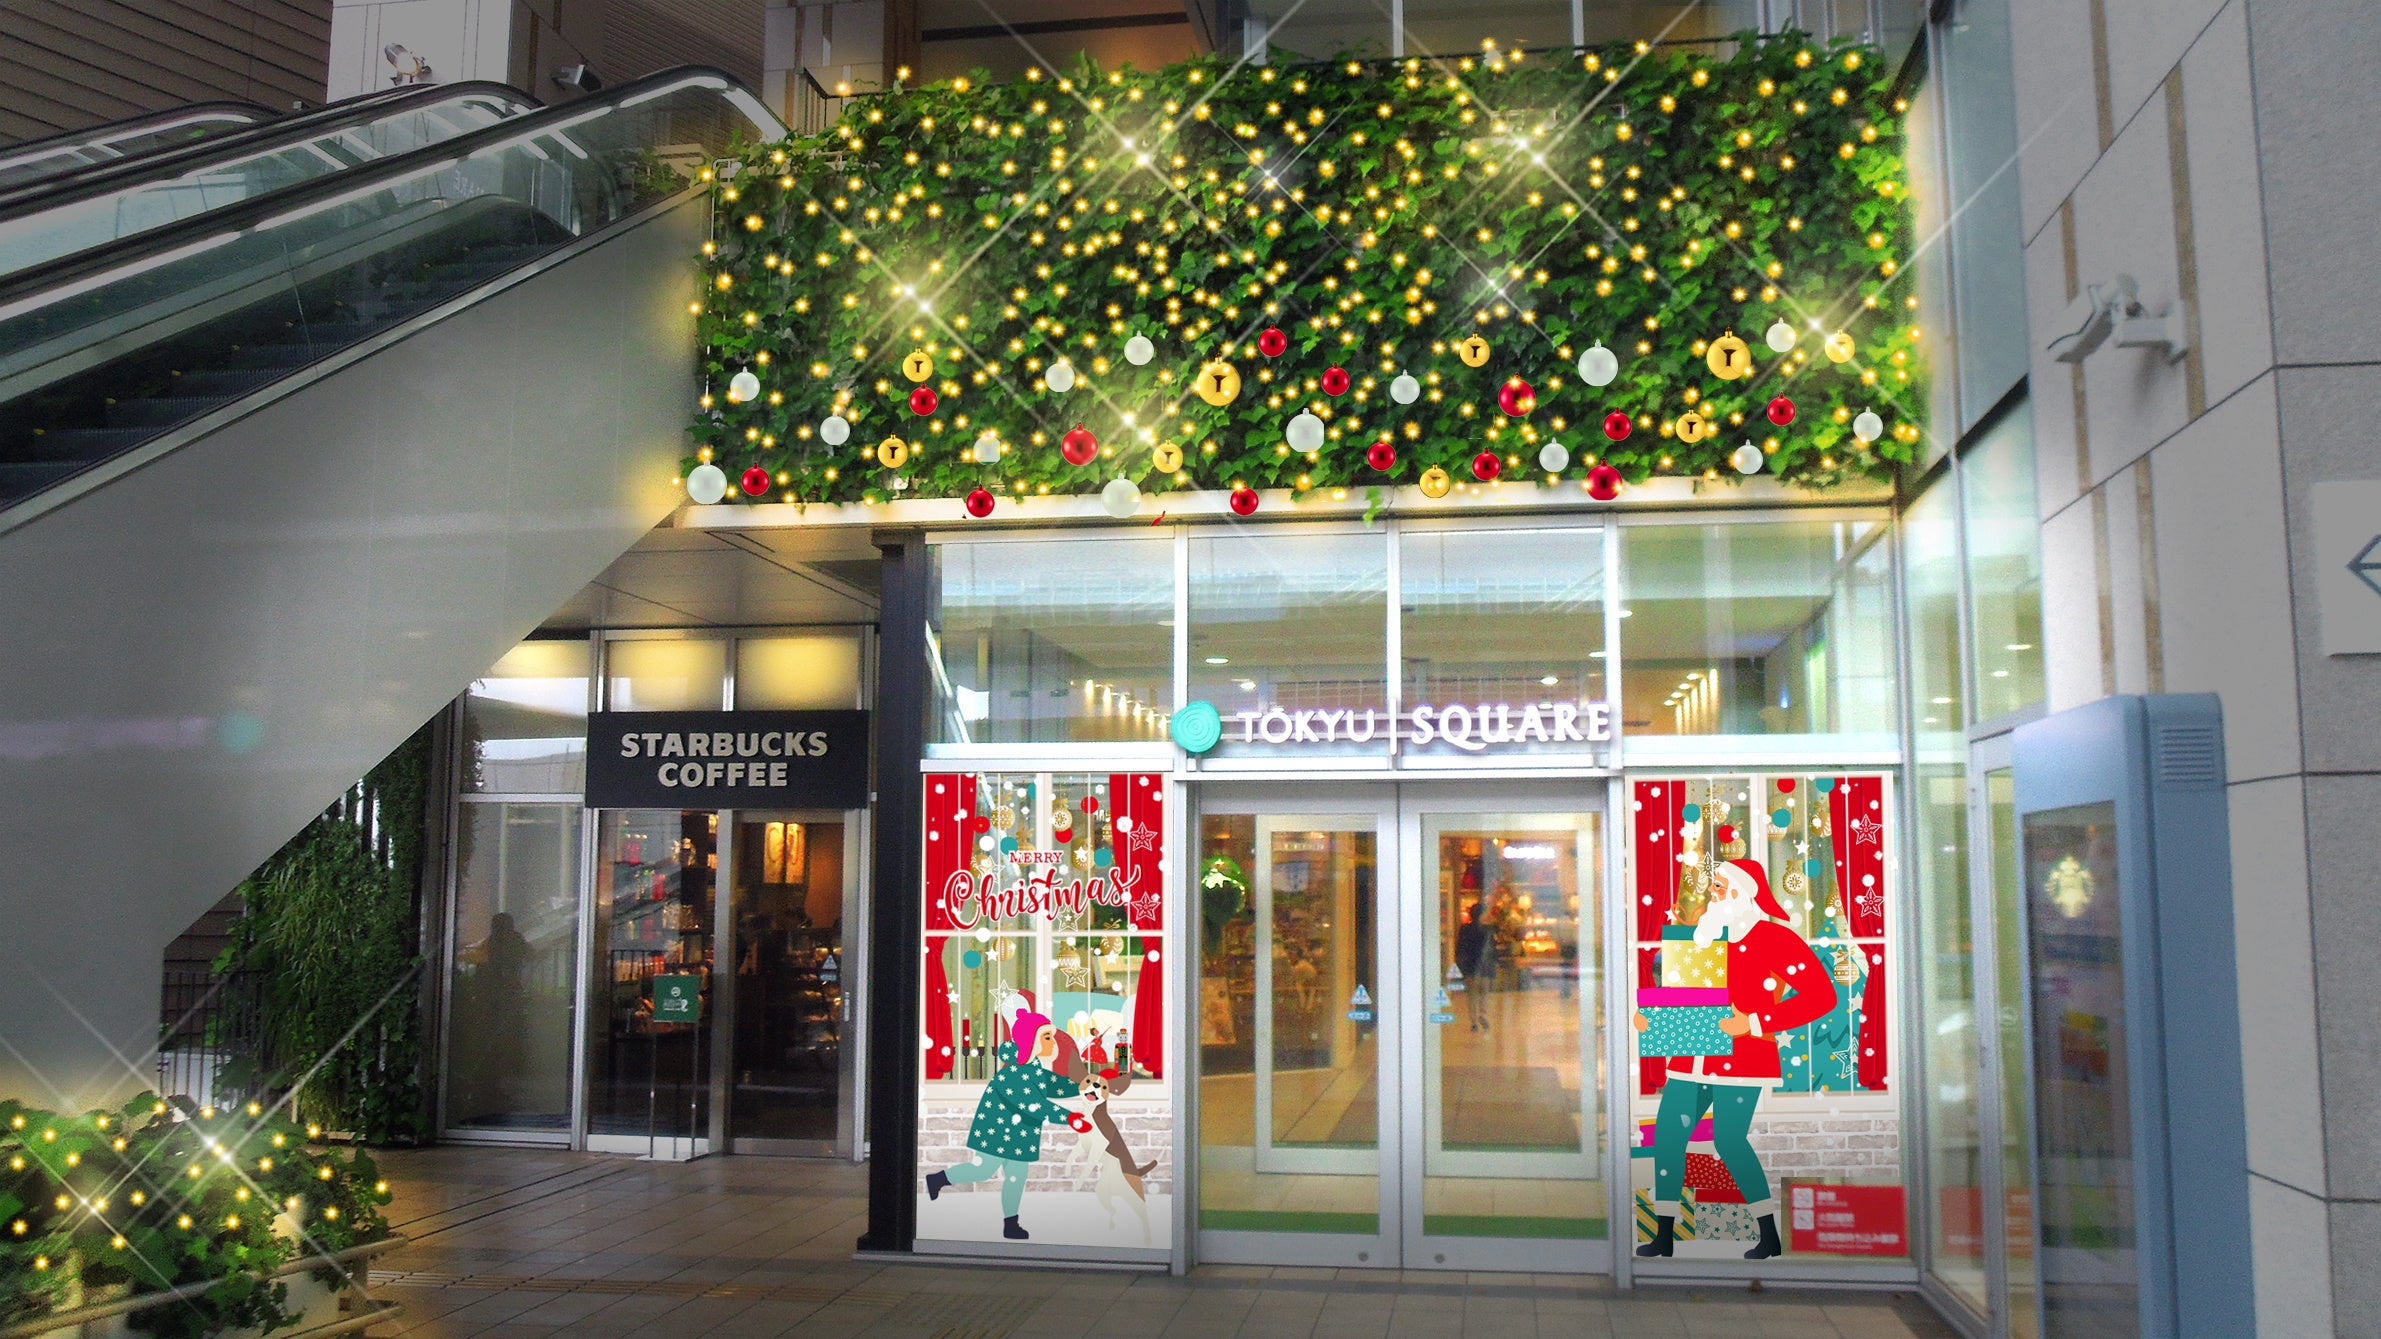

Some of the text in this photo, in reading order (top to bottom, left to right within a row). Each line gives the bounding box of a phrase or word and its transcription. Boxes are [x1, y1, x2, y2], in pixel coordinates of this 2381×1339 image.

[1411, 703, 1611, 751] SQUARE
[620, 732, 828, 758] STARBUCKS
[658, 762, 788, 788] COFFEE
[1008, 851, 1064, 864] MERRY
[943, 864, 1143, 931] Christmas
